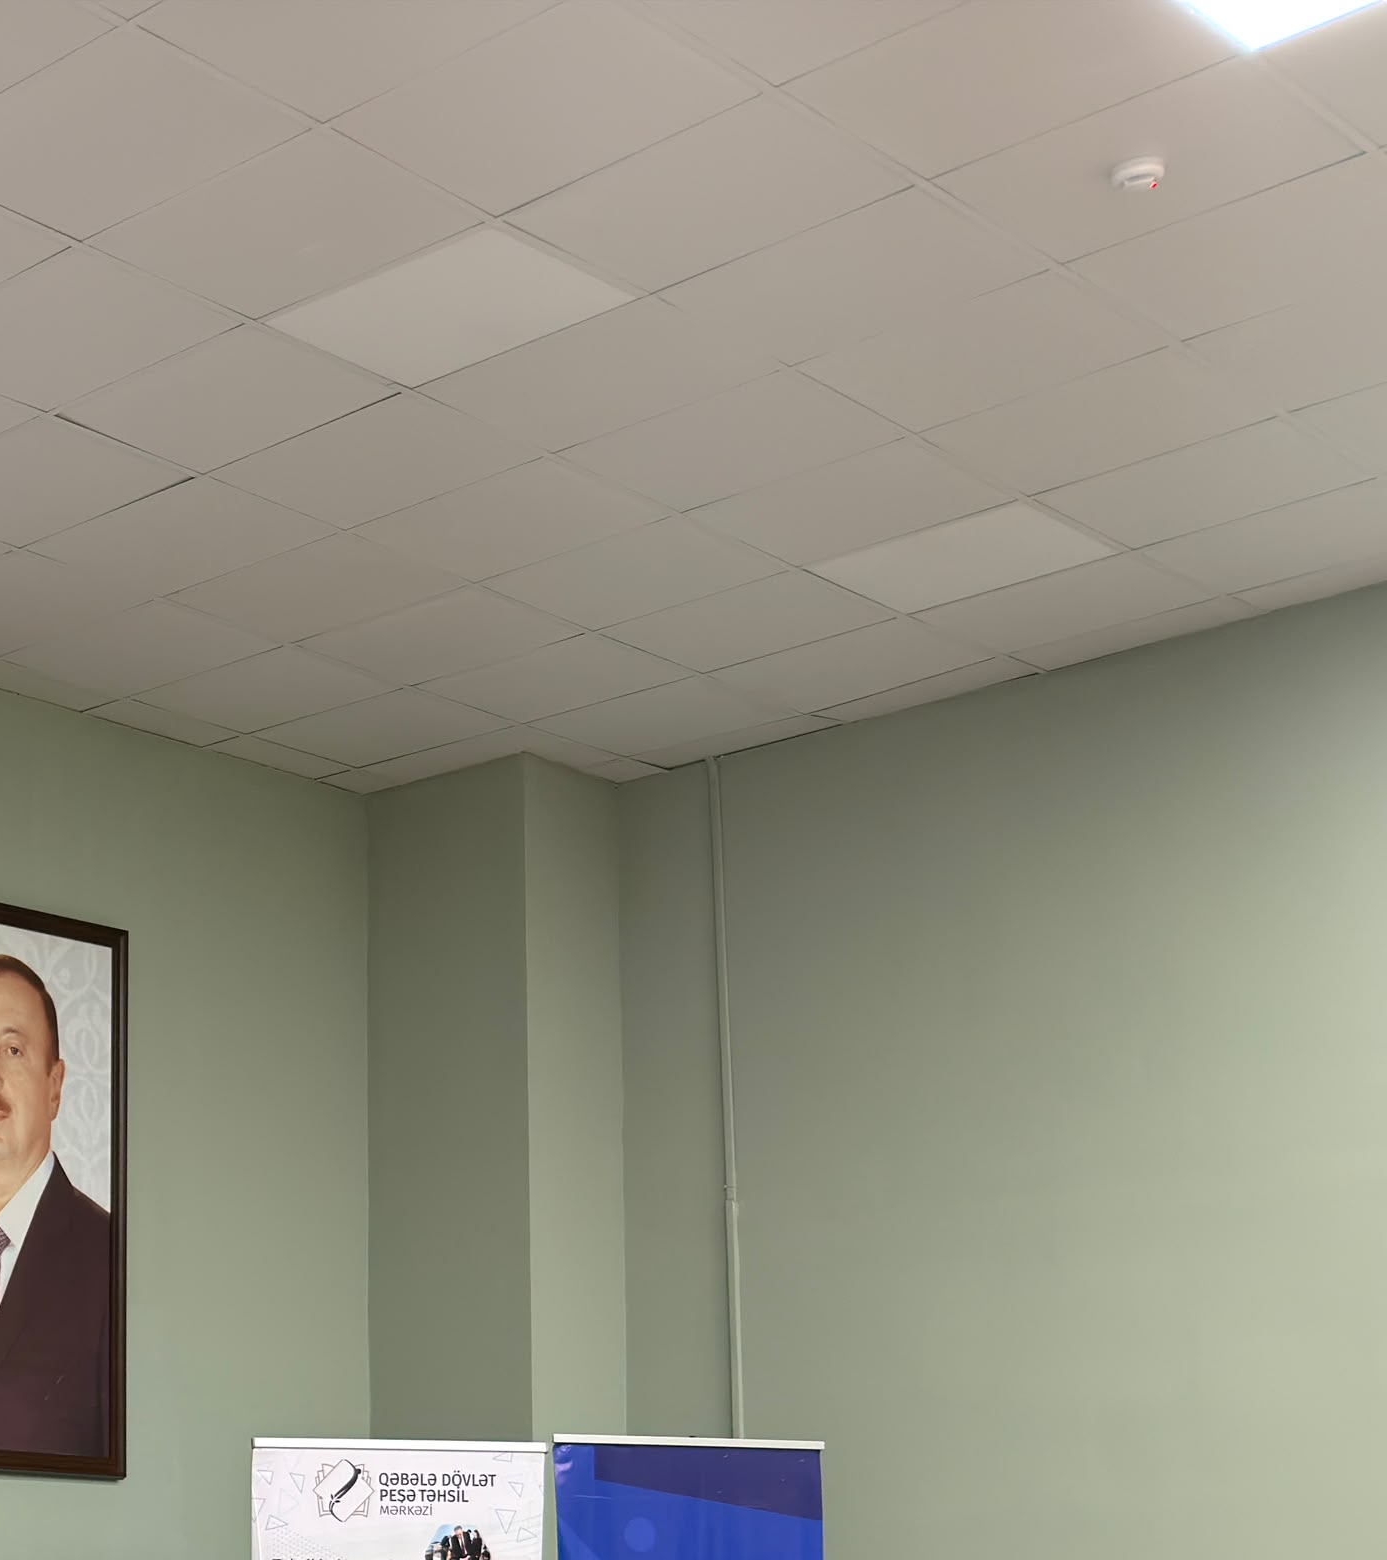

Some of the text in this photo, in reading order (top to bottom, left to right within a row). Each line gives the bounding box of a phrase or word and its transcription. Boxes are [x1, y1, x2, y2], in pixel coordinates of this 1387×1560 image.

[378, 1470, 497, 1487] QƏBƏLƏ DÖVLƏT
[379, 1486, 469, 1504] PEŞƏ TƏHSİL
[379, 1503, 433, 1516] MƏRKƏZİ
